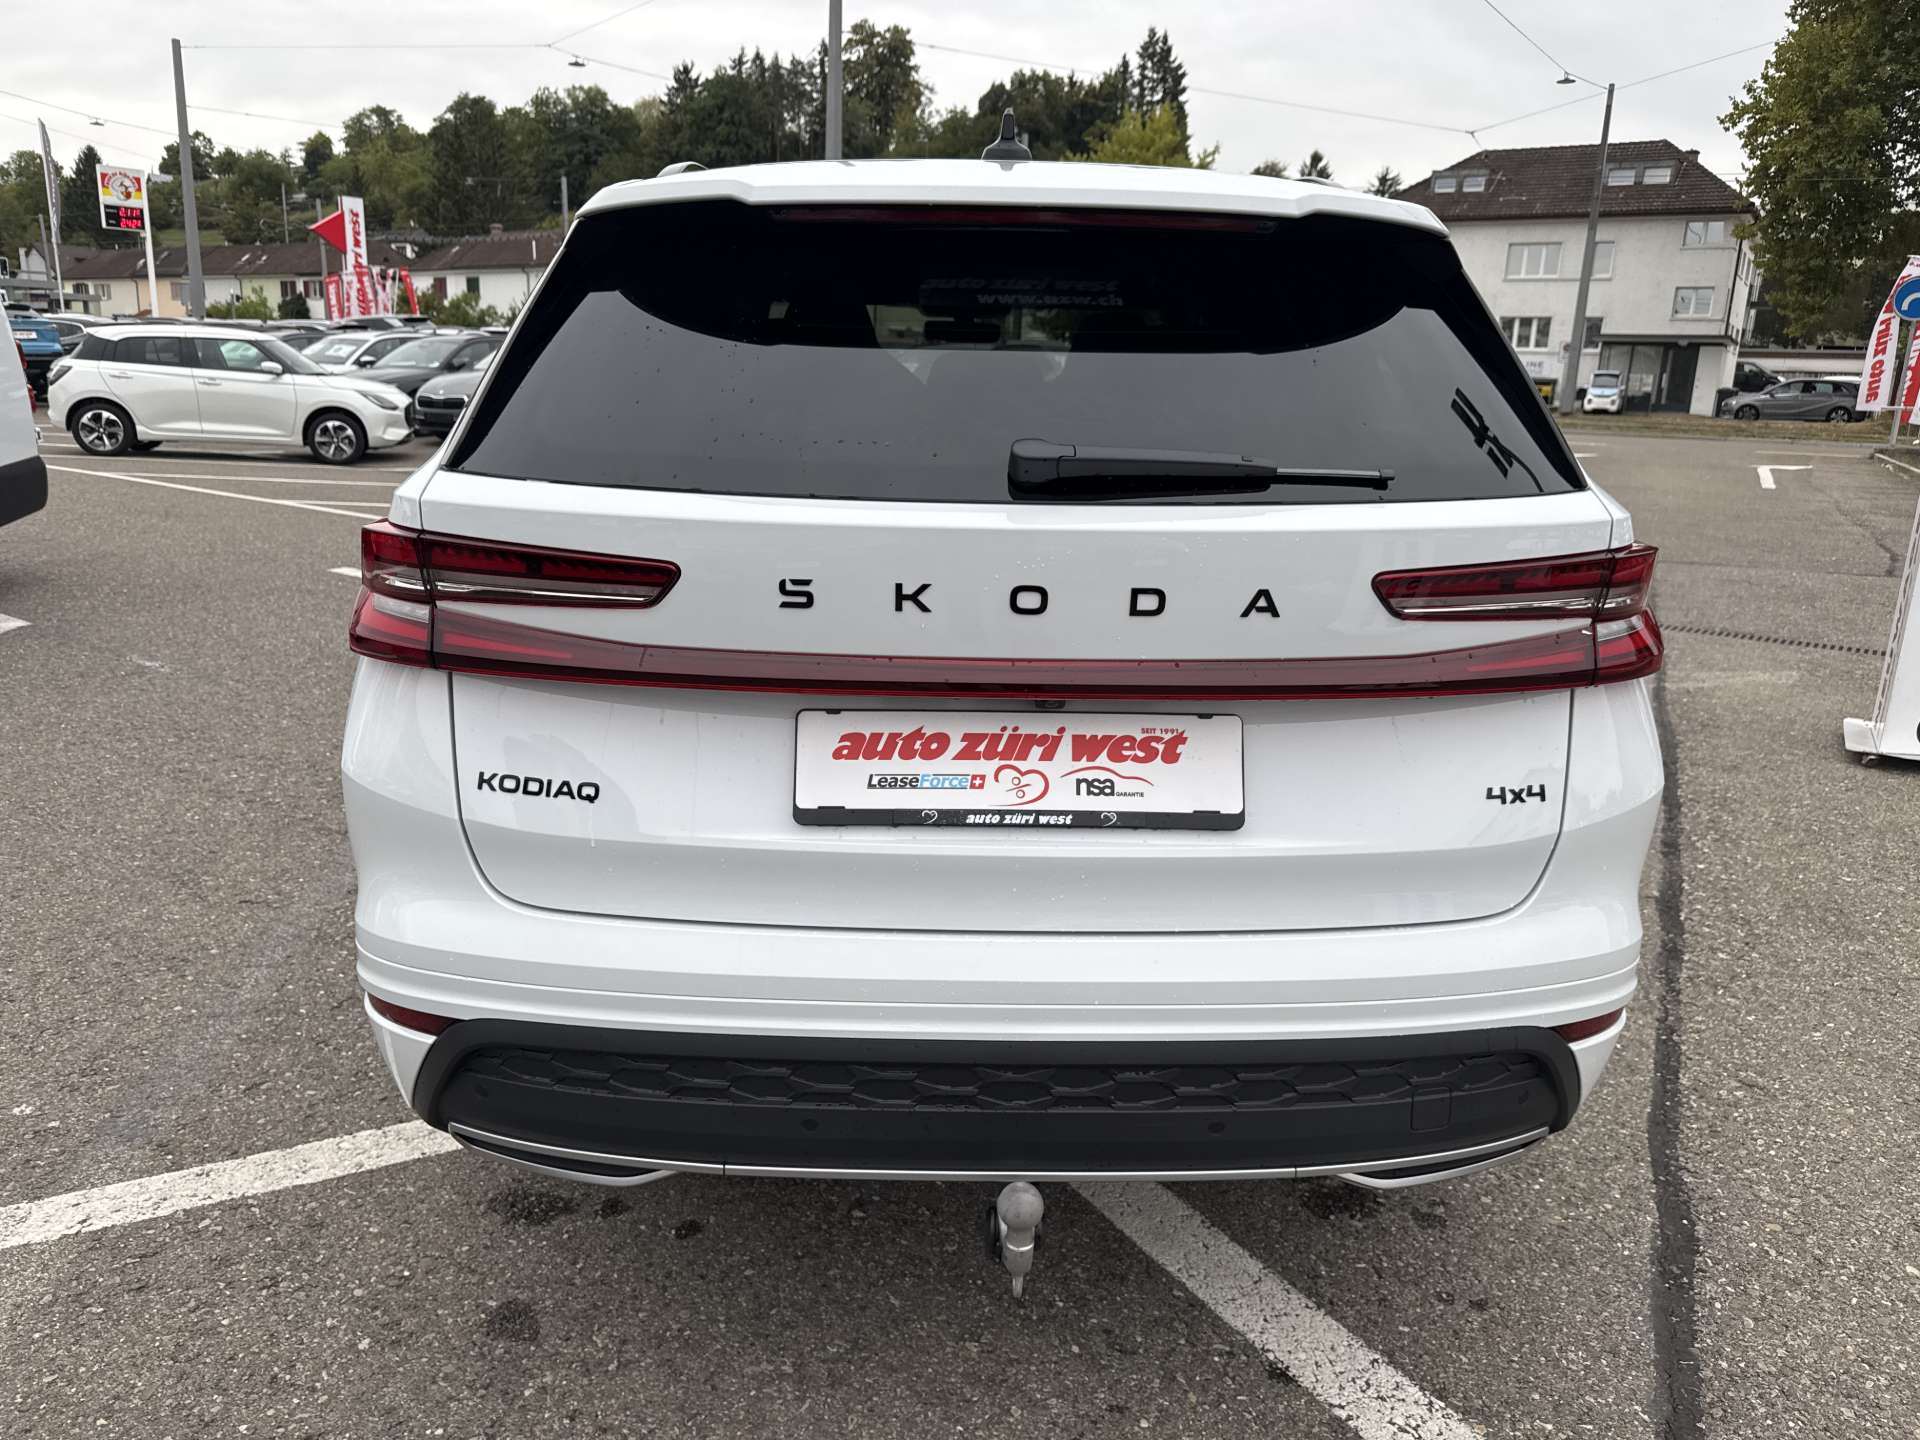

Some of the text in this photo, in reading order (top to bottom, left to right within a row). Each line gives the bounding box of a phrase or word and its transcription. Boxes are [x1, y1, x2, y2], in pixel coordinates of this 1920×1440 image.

[1141, 727, 1179, 736] SEIT 1991
[832, 725, 1188, 764] auto züri west
[477, 771, 600, 804] KODIAQ
[867, 774, 969, 789] LeaseForce
[1076, 777, 1115, 797] nsa
[1485, 783, 1546, 805] 4x4
[966, 811, 1072, 826] auto züri west
